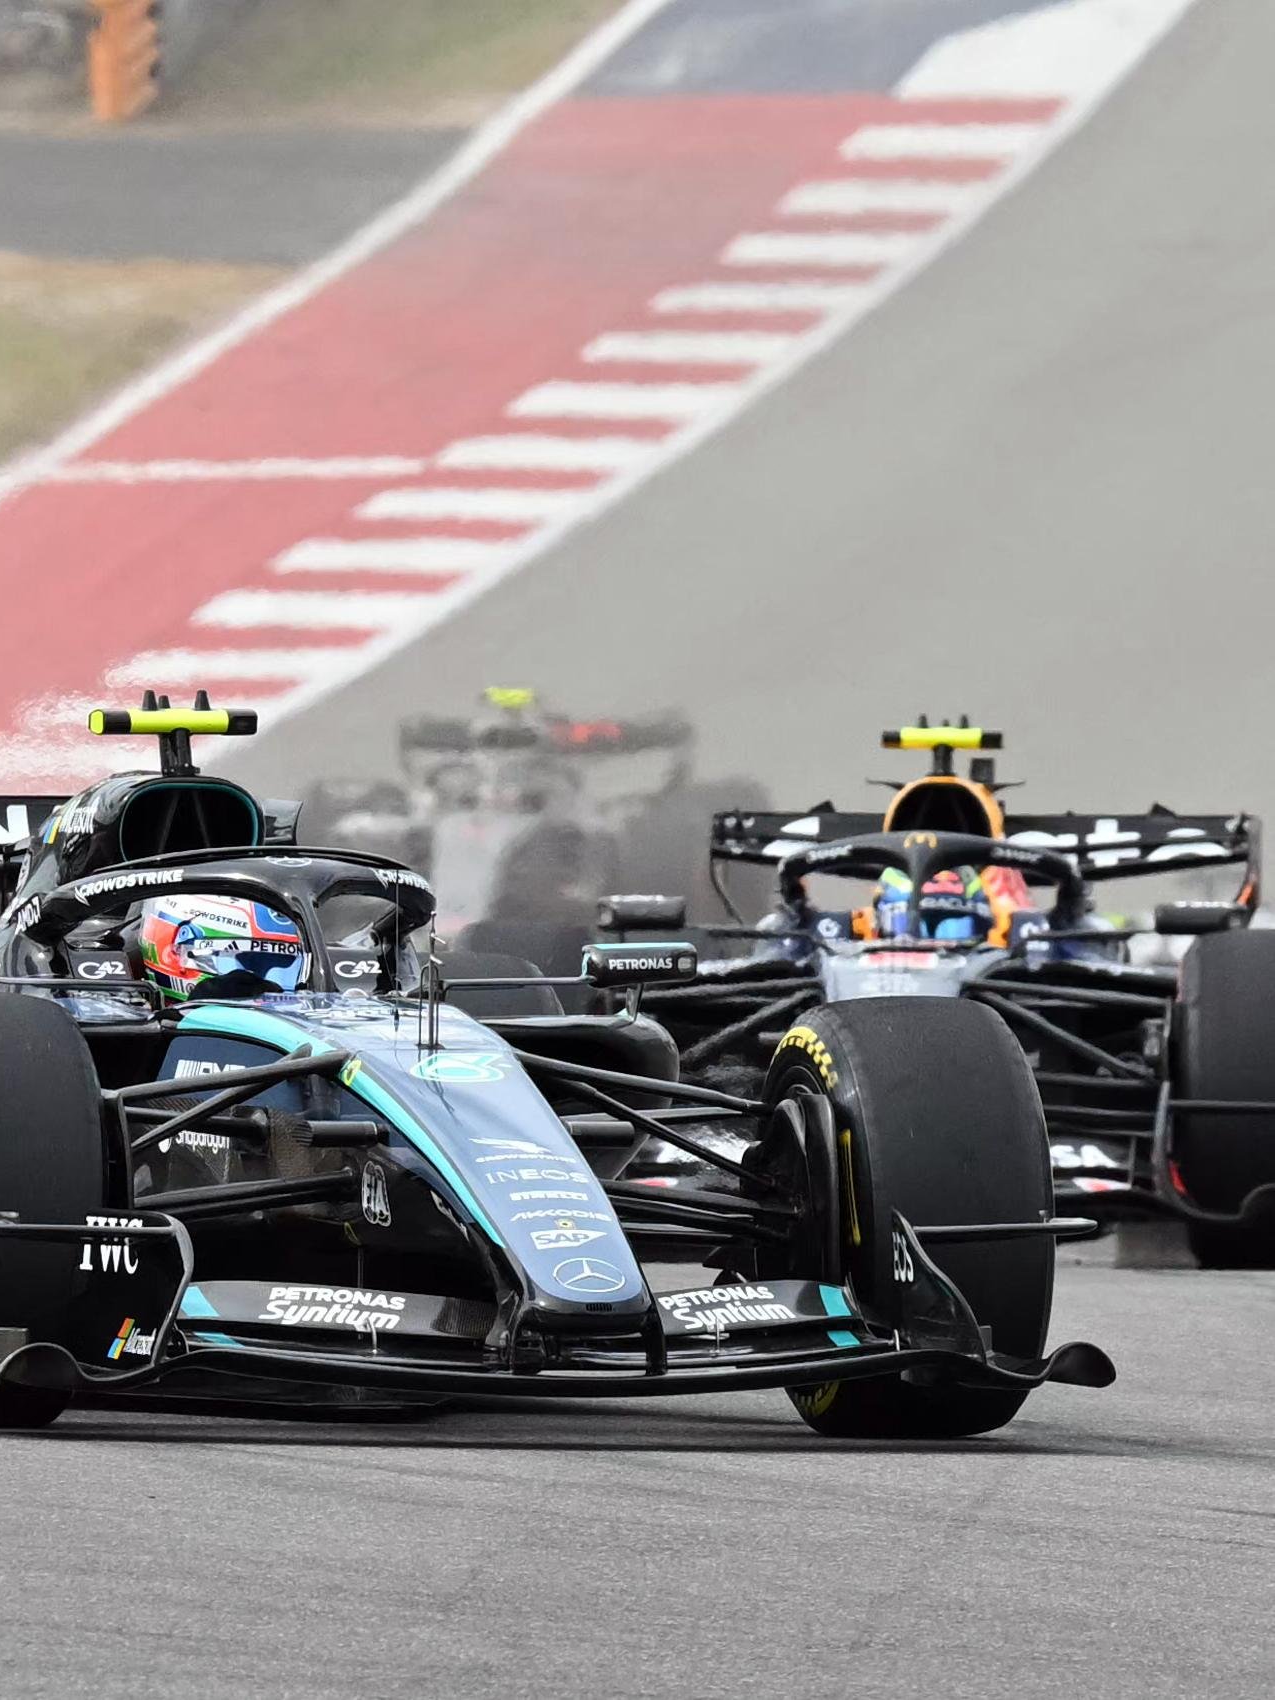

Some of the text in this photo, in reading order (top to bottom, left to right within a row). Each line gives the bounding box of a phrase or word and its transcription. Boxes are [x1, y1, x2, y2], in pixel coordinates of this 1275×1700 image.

[79, 869, 185, 897] CROWDSTRIKE
[250, 940, 303, 954] PETRON
[77, 961, 126, 980] G42
[334, 961, 383, 978] G42
[608, 958, 673, 970] PETRONAS
[485, 1168, 589, 1184] INEOS
[510, 1209, 613, 1222] AKKODIS
[535, 1232, 590, 1244] SAP
[269, 1287, 406, 1311] PETRONAS
[658, 1286, 775, 1311] PETRONAS
[259, 1299, 401, 1333] Syntium
[673, 1300, 796, 1332] Syntium
